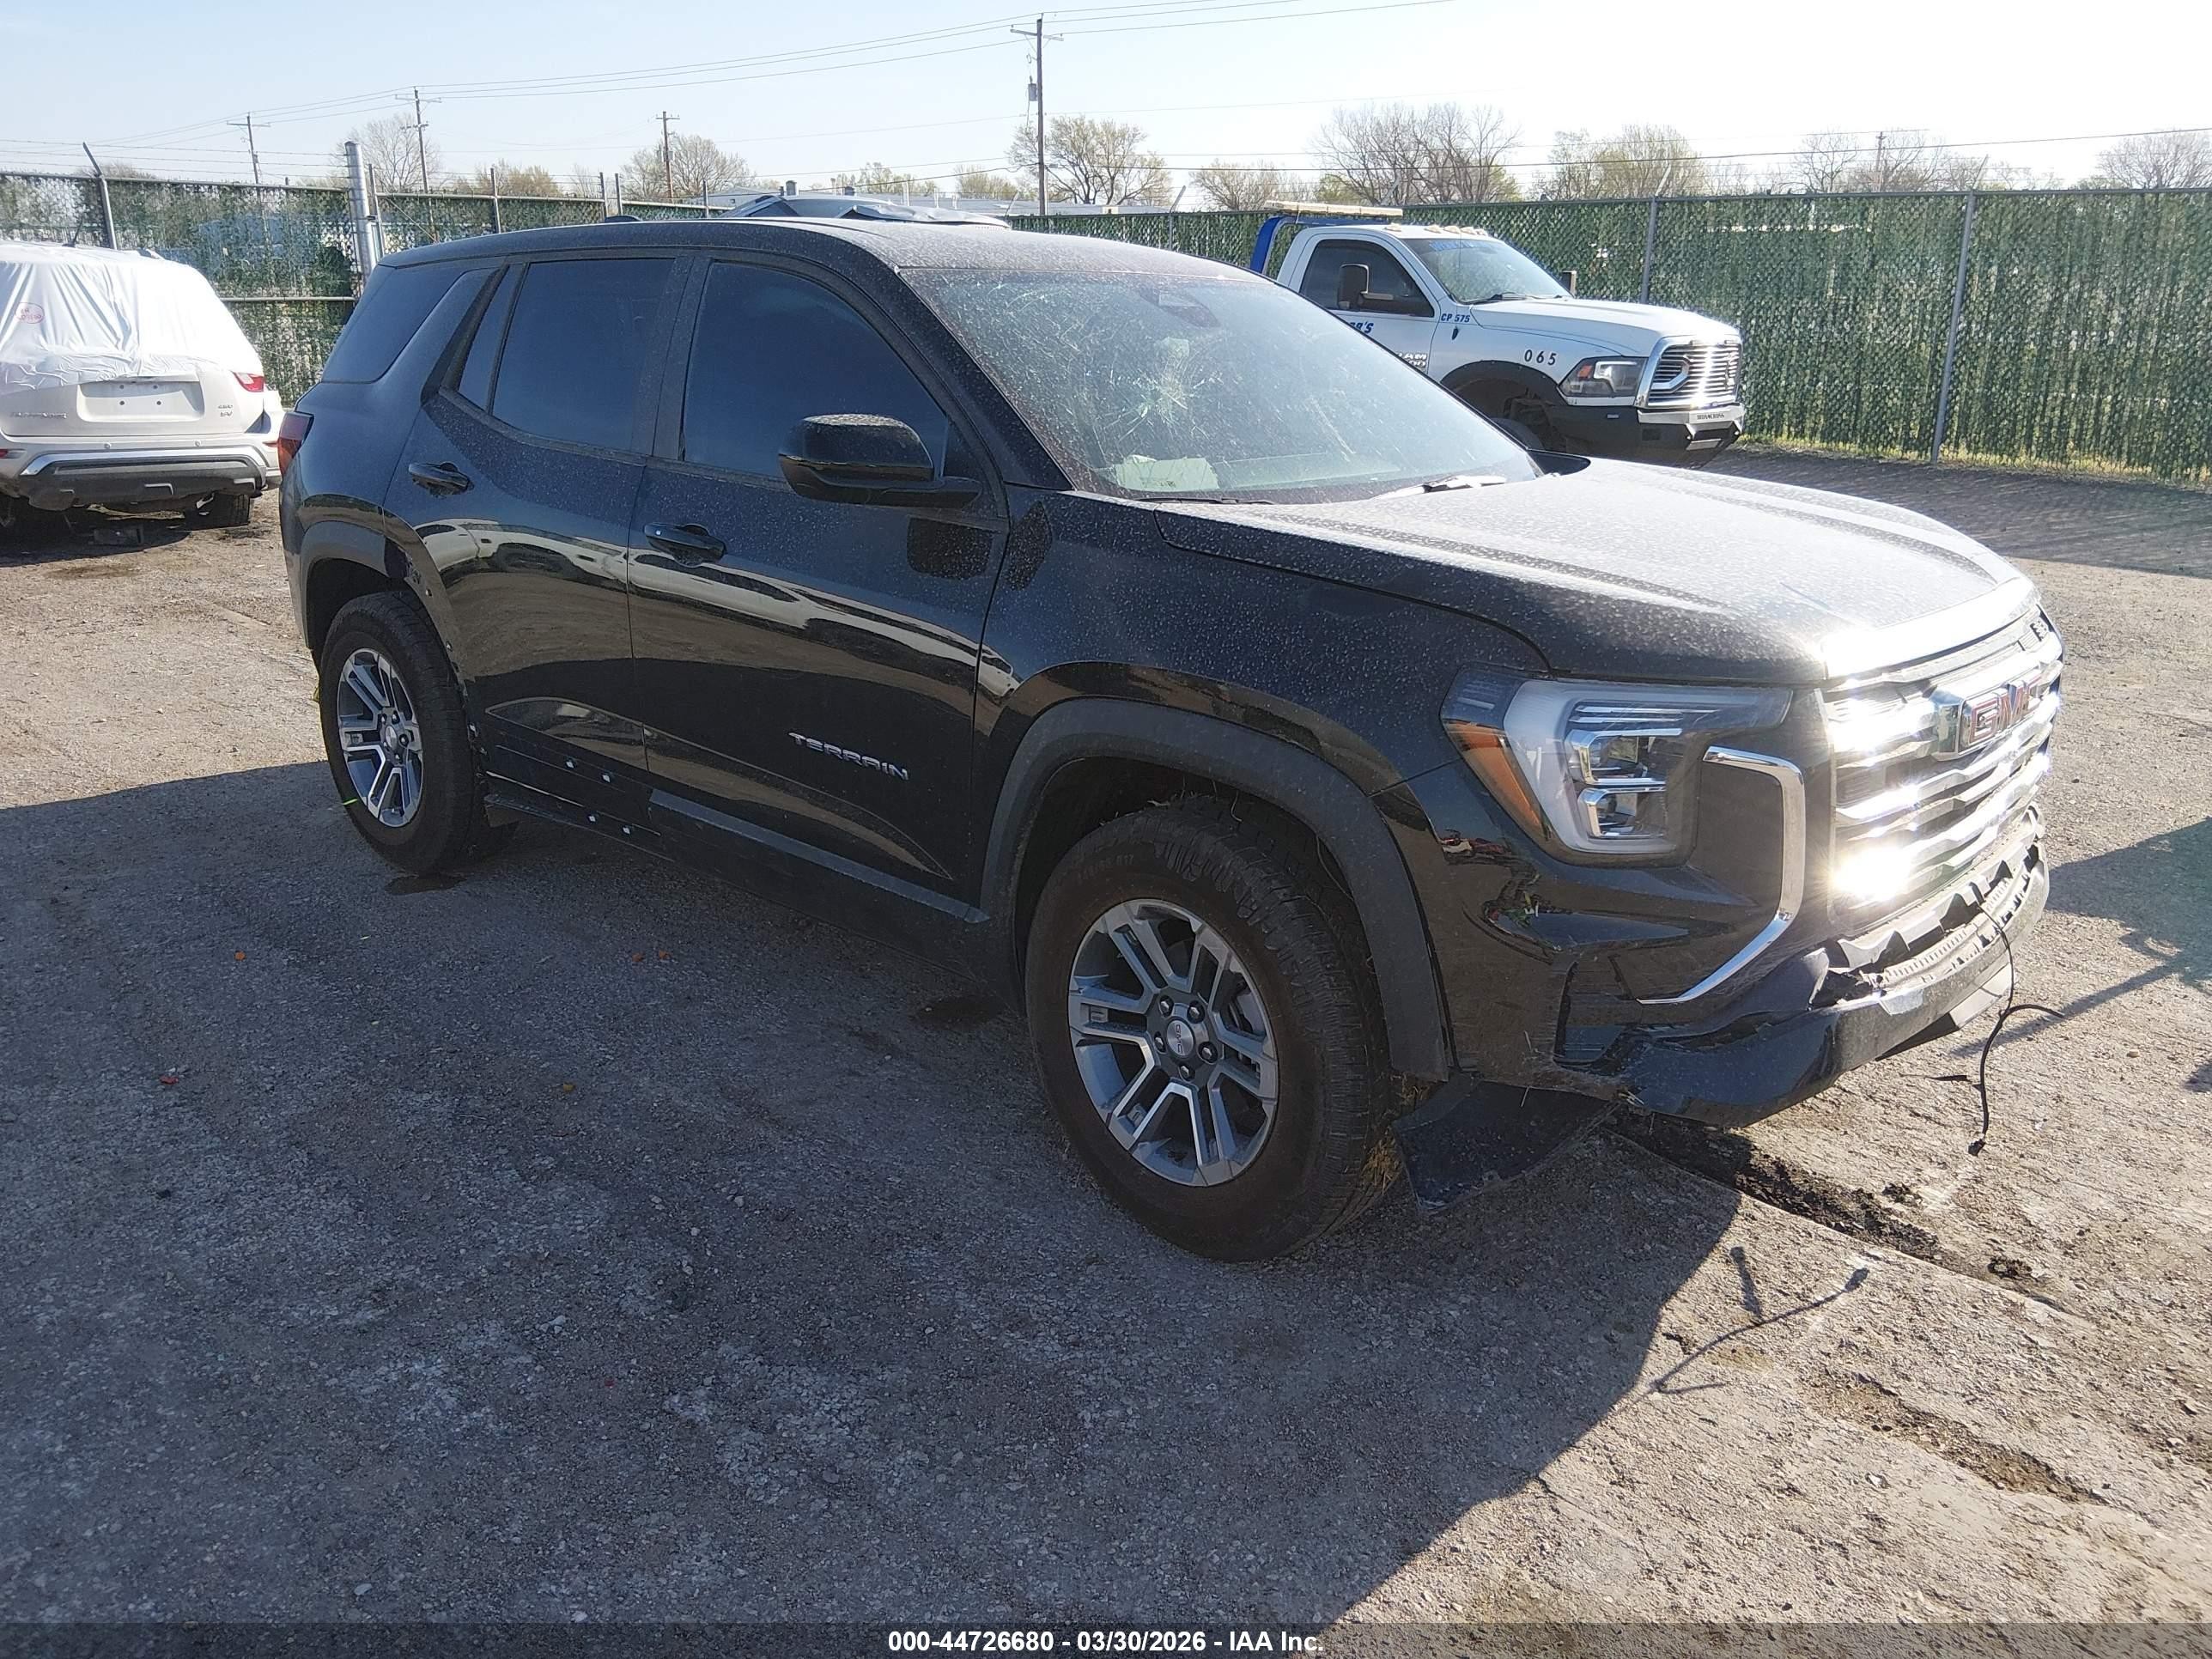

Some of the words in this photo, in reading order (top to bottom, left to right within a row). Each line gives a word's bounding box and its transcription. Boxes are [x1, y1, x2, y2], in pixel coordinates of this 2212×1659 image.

[1440, 313, 1453, 322] CP
[1454, 313, 1471, 323] 575
[1523, 349, 1557, 366] 065
[1967, 670, 2043, 744] GMC
[787, 732, 909, 781] TERRAIN
